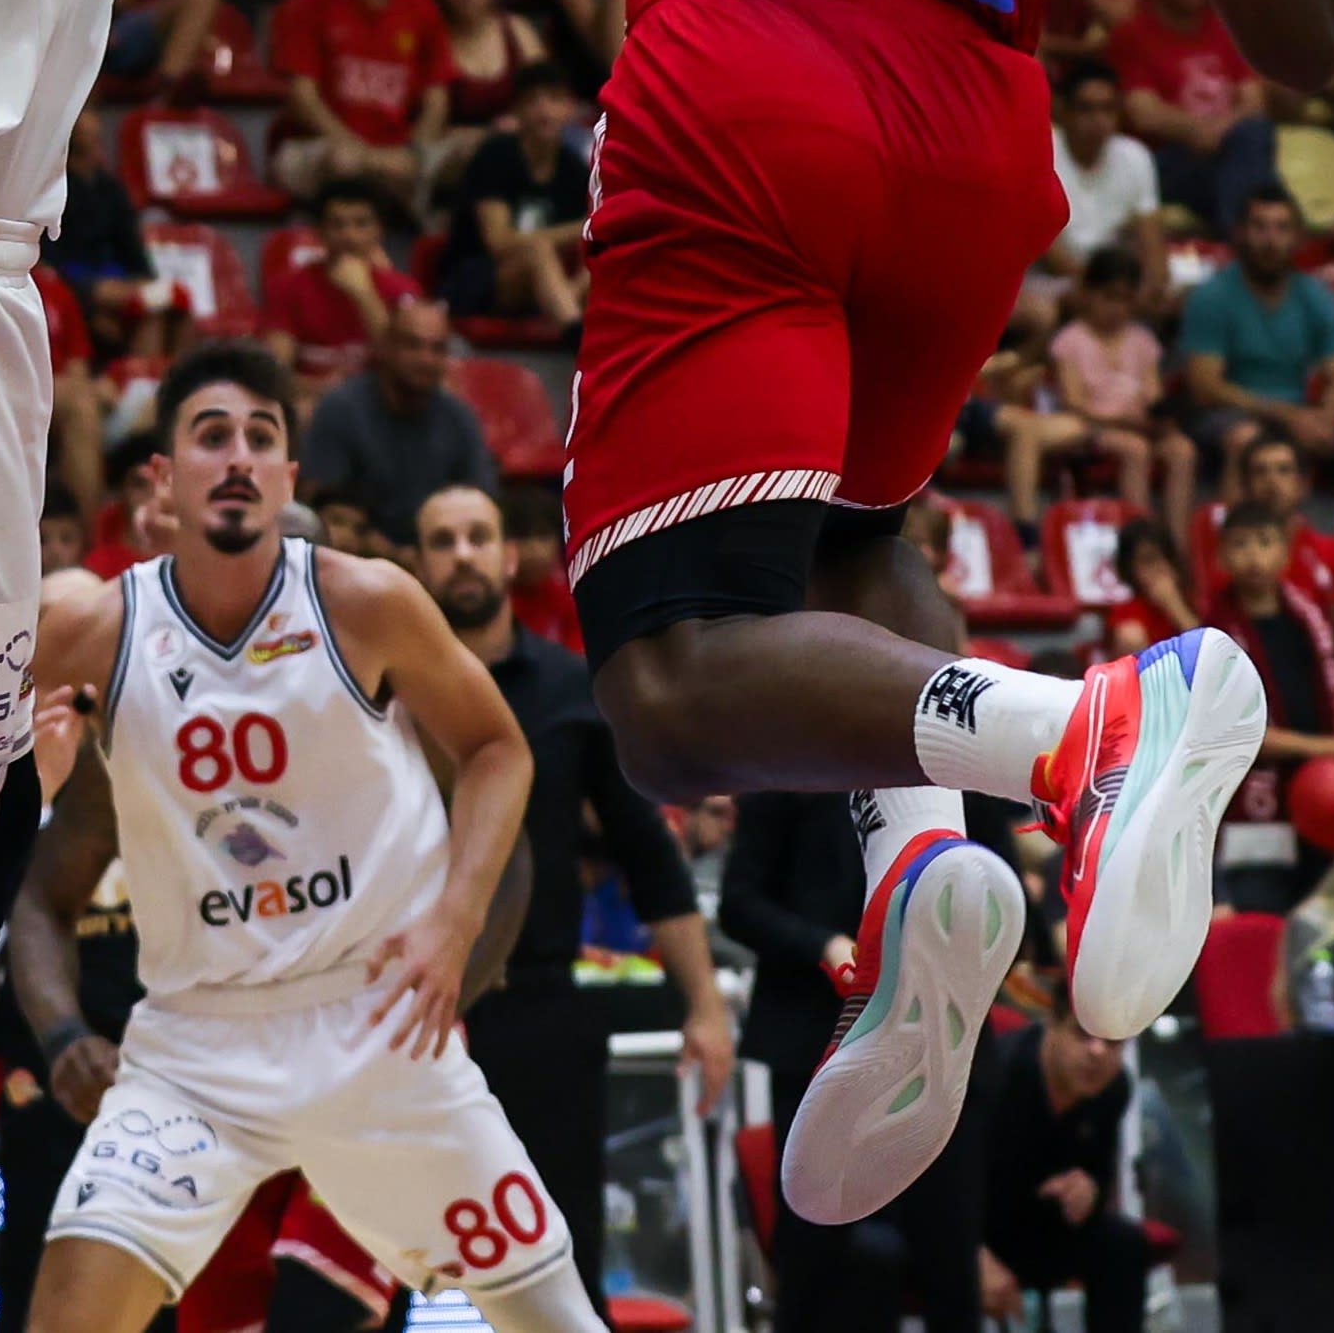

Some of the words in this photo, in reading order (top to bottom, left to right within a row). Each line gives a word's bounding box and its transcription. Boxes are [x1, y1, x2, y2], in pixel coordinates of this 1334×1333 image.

[177, 711, 289, 793] 80
[200, 854, 353, 927] evasol
[443, 1170, 547, 1270] 80
